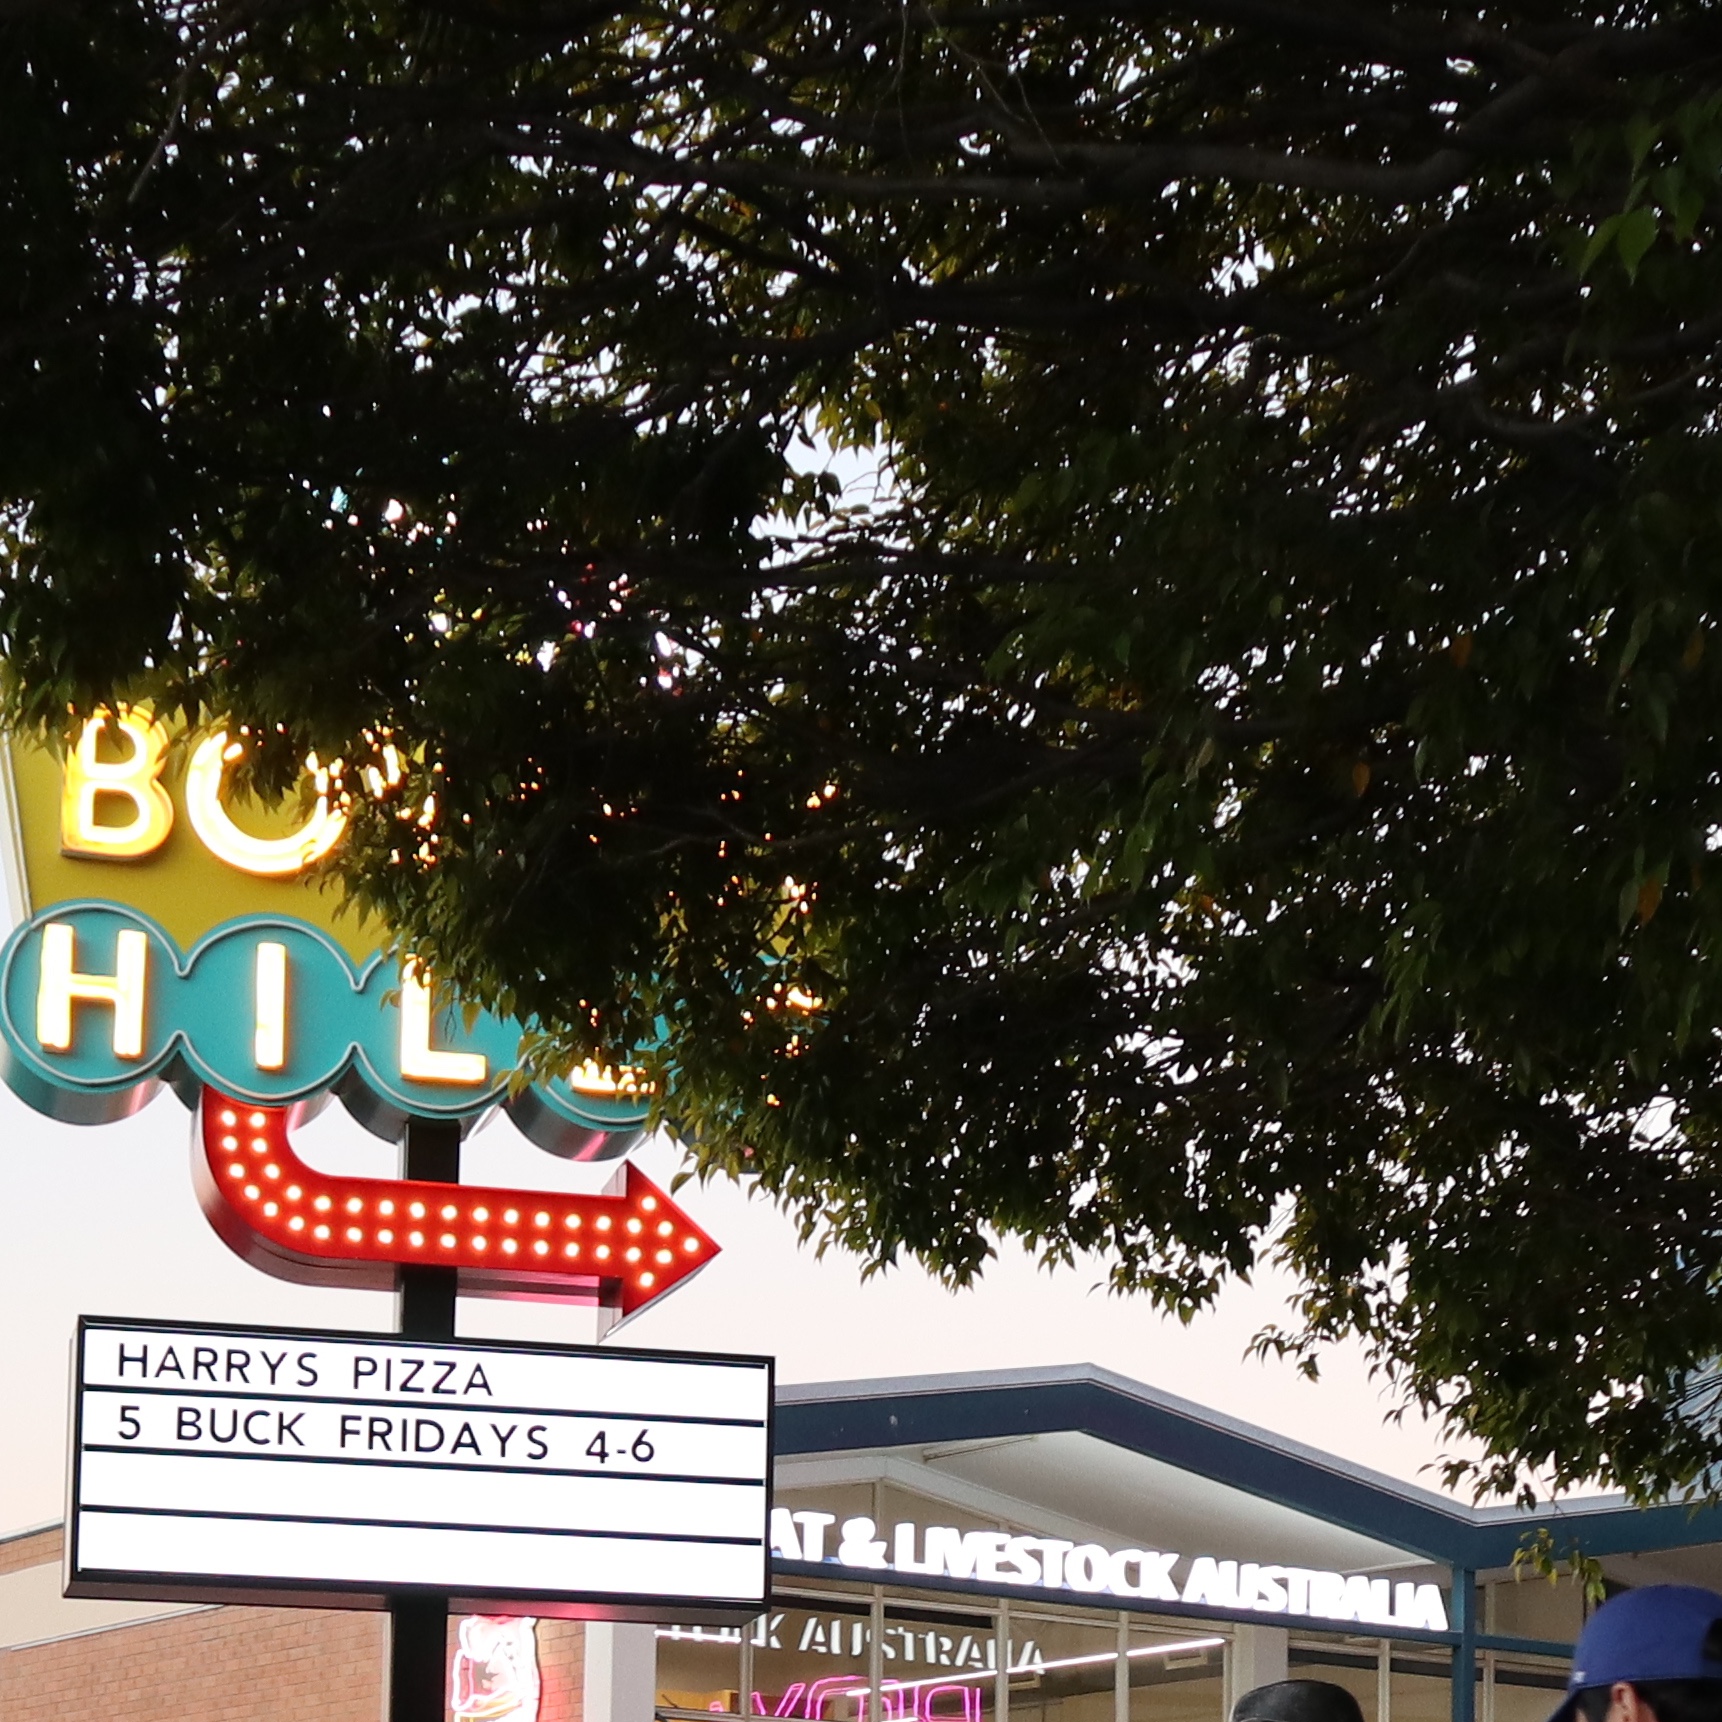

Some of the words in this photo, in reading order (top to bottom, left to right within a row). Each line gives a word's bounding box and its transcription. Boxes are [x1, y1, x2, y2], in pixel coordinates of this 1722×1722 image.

[118, 1343, 318, 1388] HARRYS
[352, 1356, 492, 1397] PIZZA
[118, 1405, 141, 1441] 5
[176, 1406, 305, 1447] BUCK
[340, 1415, 549, 1461] FRIDAYS
[585, 1428, 655, 1464] 4-6
[838, 1516, 888, 1569] &
[894, 1522, 1181, 1601] LIVESTOCK
[1181, 1556, 1449, 1632] AUSTRALIA
